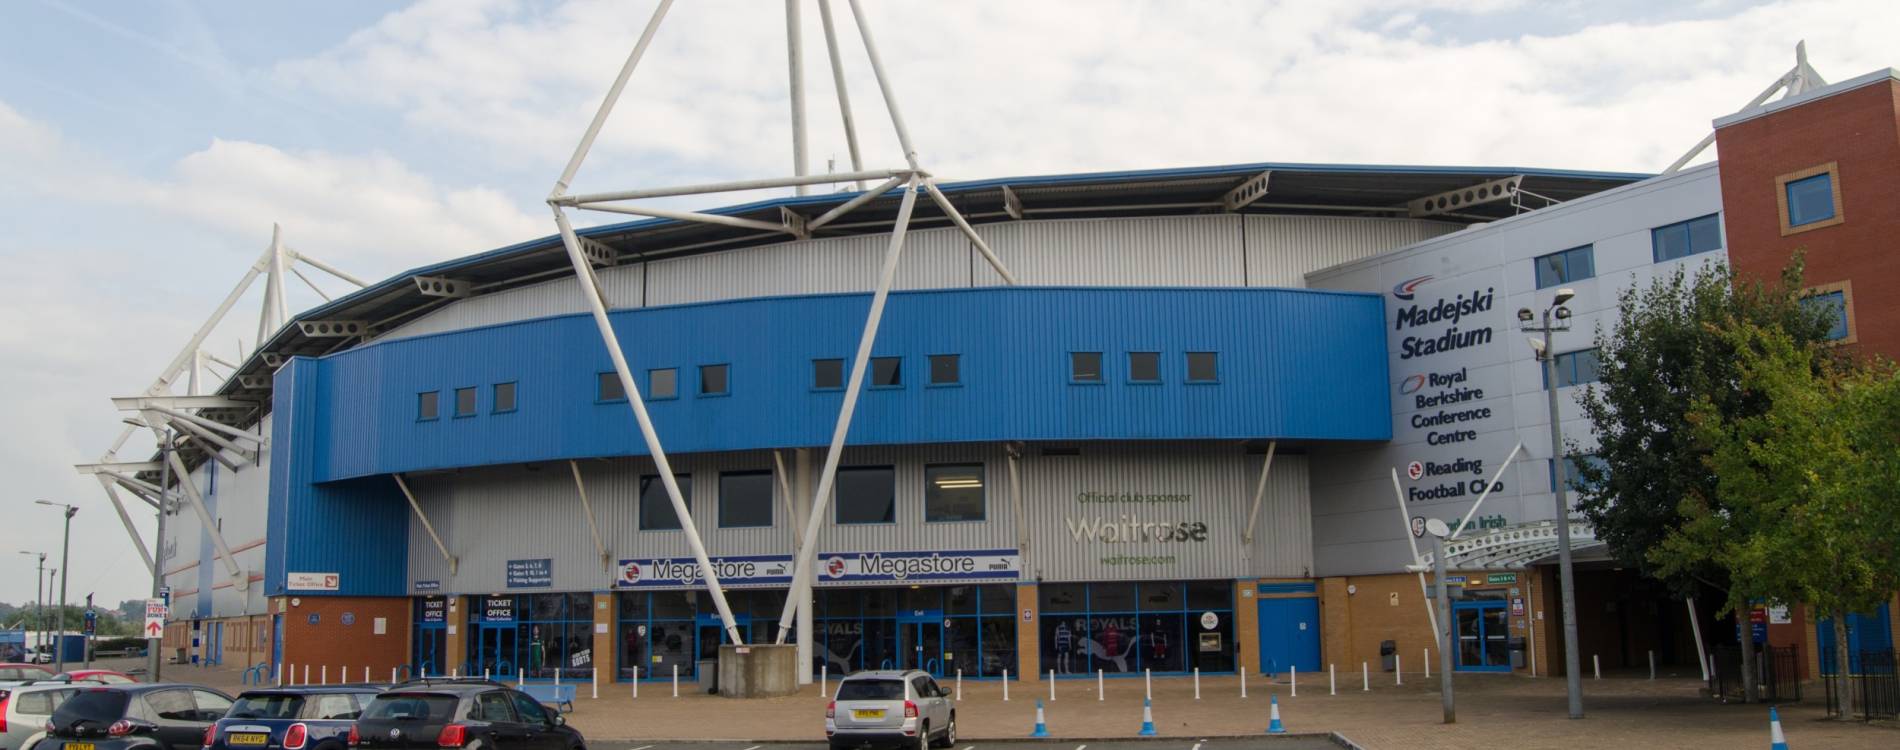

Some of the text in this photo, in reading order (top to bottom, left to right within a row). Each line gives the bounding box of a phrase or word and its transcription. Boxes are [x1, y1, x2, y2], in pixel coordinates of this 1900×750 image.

[1396, 287, 1494, 330] Madejski
[1400, 327, 1492, 360] Stadium
[1428, 367, 1467, 388] Royal
[1415, 387, 1484, 409] Berkshire
[1411, 406, 1491, 429] Conference
[1427, 428, 1477, 447] Centre
[1425, 457, 1483, 477] Reading
[1077, 491, 1192, 506] Official club sponsor
[1408, 481, 1465, 502] Football
[1065, 513, 1208, 544] Waitrose
[1478, 513, 1507, 529] Irish
[859, 555, 975, 578] Megastore
[1099, 553, 1176, 566] waitrose.com
[486, 599, 512, 607] TICKET
[487, 609, 512, 617] OFFICE
[1074, 616, 1137, 632] ROYALS
